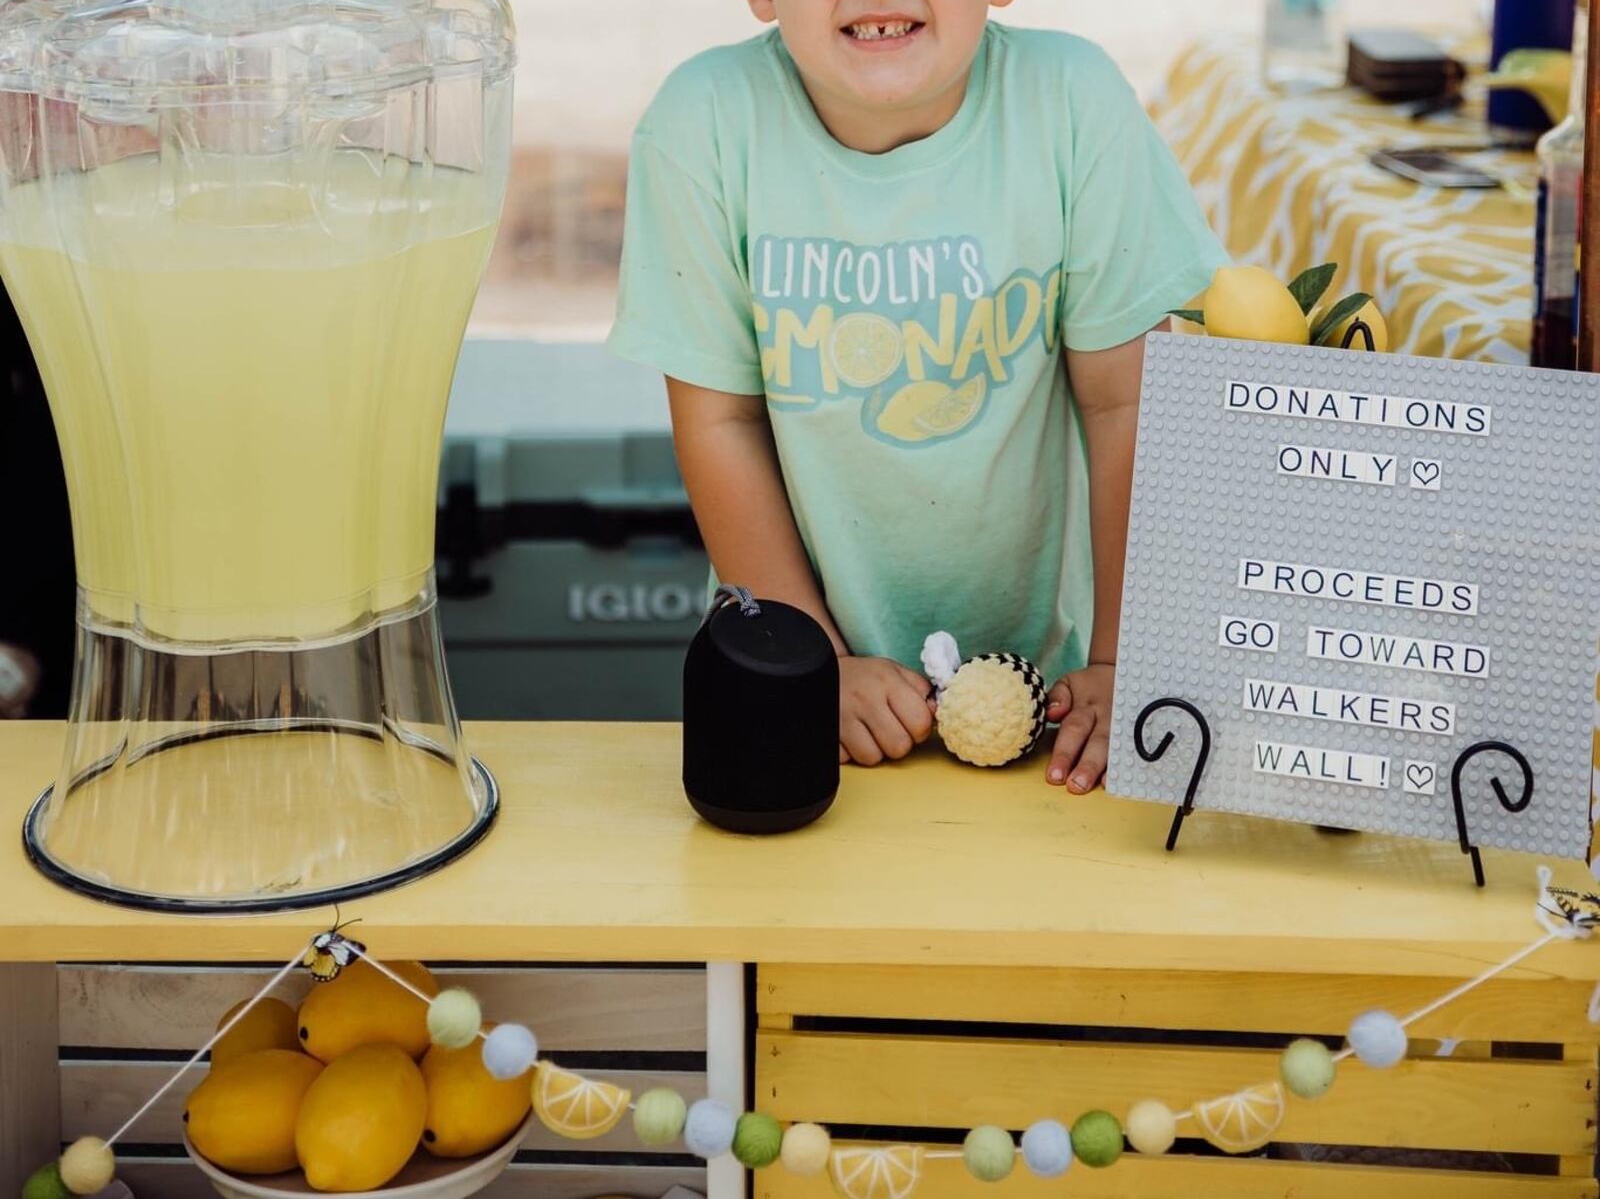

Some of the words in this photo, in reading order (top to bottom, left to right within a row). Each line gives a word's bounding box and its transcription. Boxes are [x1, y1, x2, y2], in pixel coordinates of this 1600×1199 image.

[761, 240, 983, 304] LINCOLN'S
[1229, 383, 1486, 432] DONATIONS
[1279, 447, 1392, 481] ONLY
[1244, 562, 1472, 611] PROCEEDS
[1225, 620, 1274, 647] GO
[1315, 629, 1485, 674] TOWARD
[1249, 682, 1450, 731] WALKERS
[1257, 743, 1386, 786] WALL!
